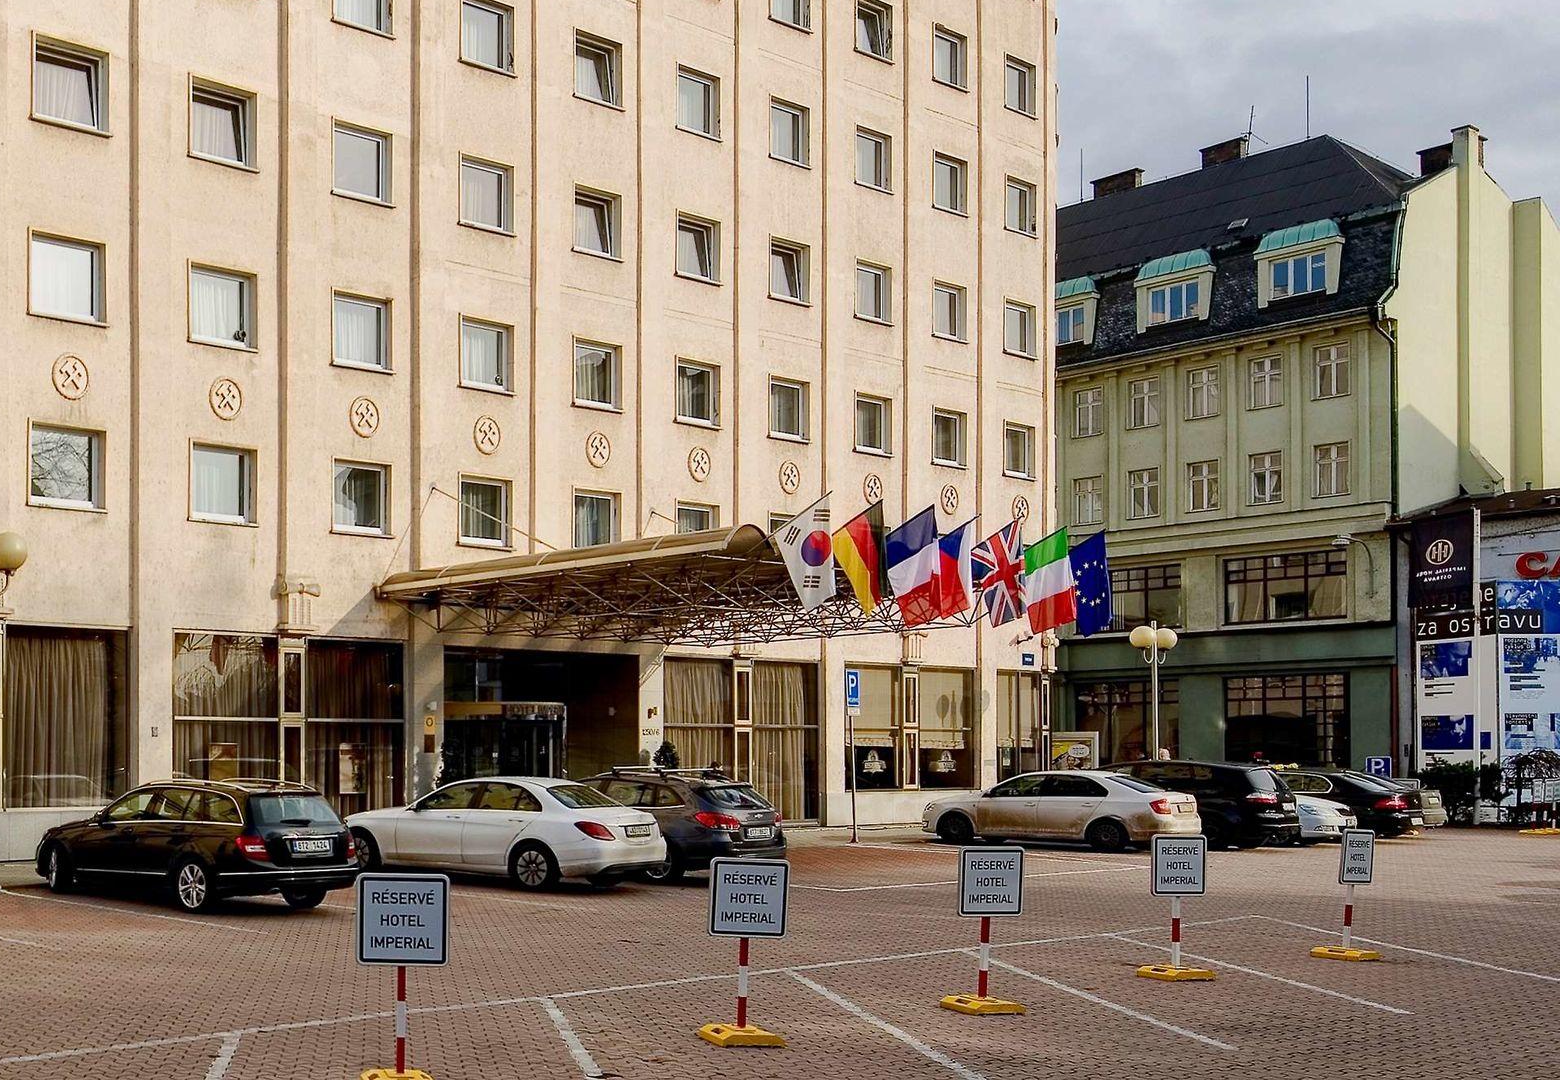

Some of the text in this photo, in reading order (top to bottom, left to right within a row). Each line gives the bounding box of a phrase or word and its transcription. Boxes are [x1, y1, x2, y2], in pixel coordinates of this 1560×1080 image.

[1417, 614, 1541, 636] za osravu
[848, 674, 857, 696] P
[1370, 759, 1385, 774] P
[1161, 843, 1199, 856] RÉSERVÉ
[970, 857, 1015, 871] RÉSERVÉ
[1166, 861, 1193, 870] HOTEL
[723, 870, 778, 886] RÉSERVÉ
[976, 877, 1007, 887] HOTEL
[1160, 876, 1199, 885] IMPERIAL
[371, 888, 435, 906] RÉSERVÉ
[730, 892, 768, 905] HOTEL
[968, 893, 1014, 904] IMPERIAL
[380, 914, 426, 927] HOTEL
[720, 911, 776, 924] IMPERIAL
[370, 935, 435, 950] IMPERIAL
